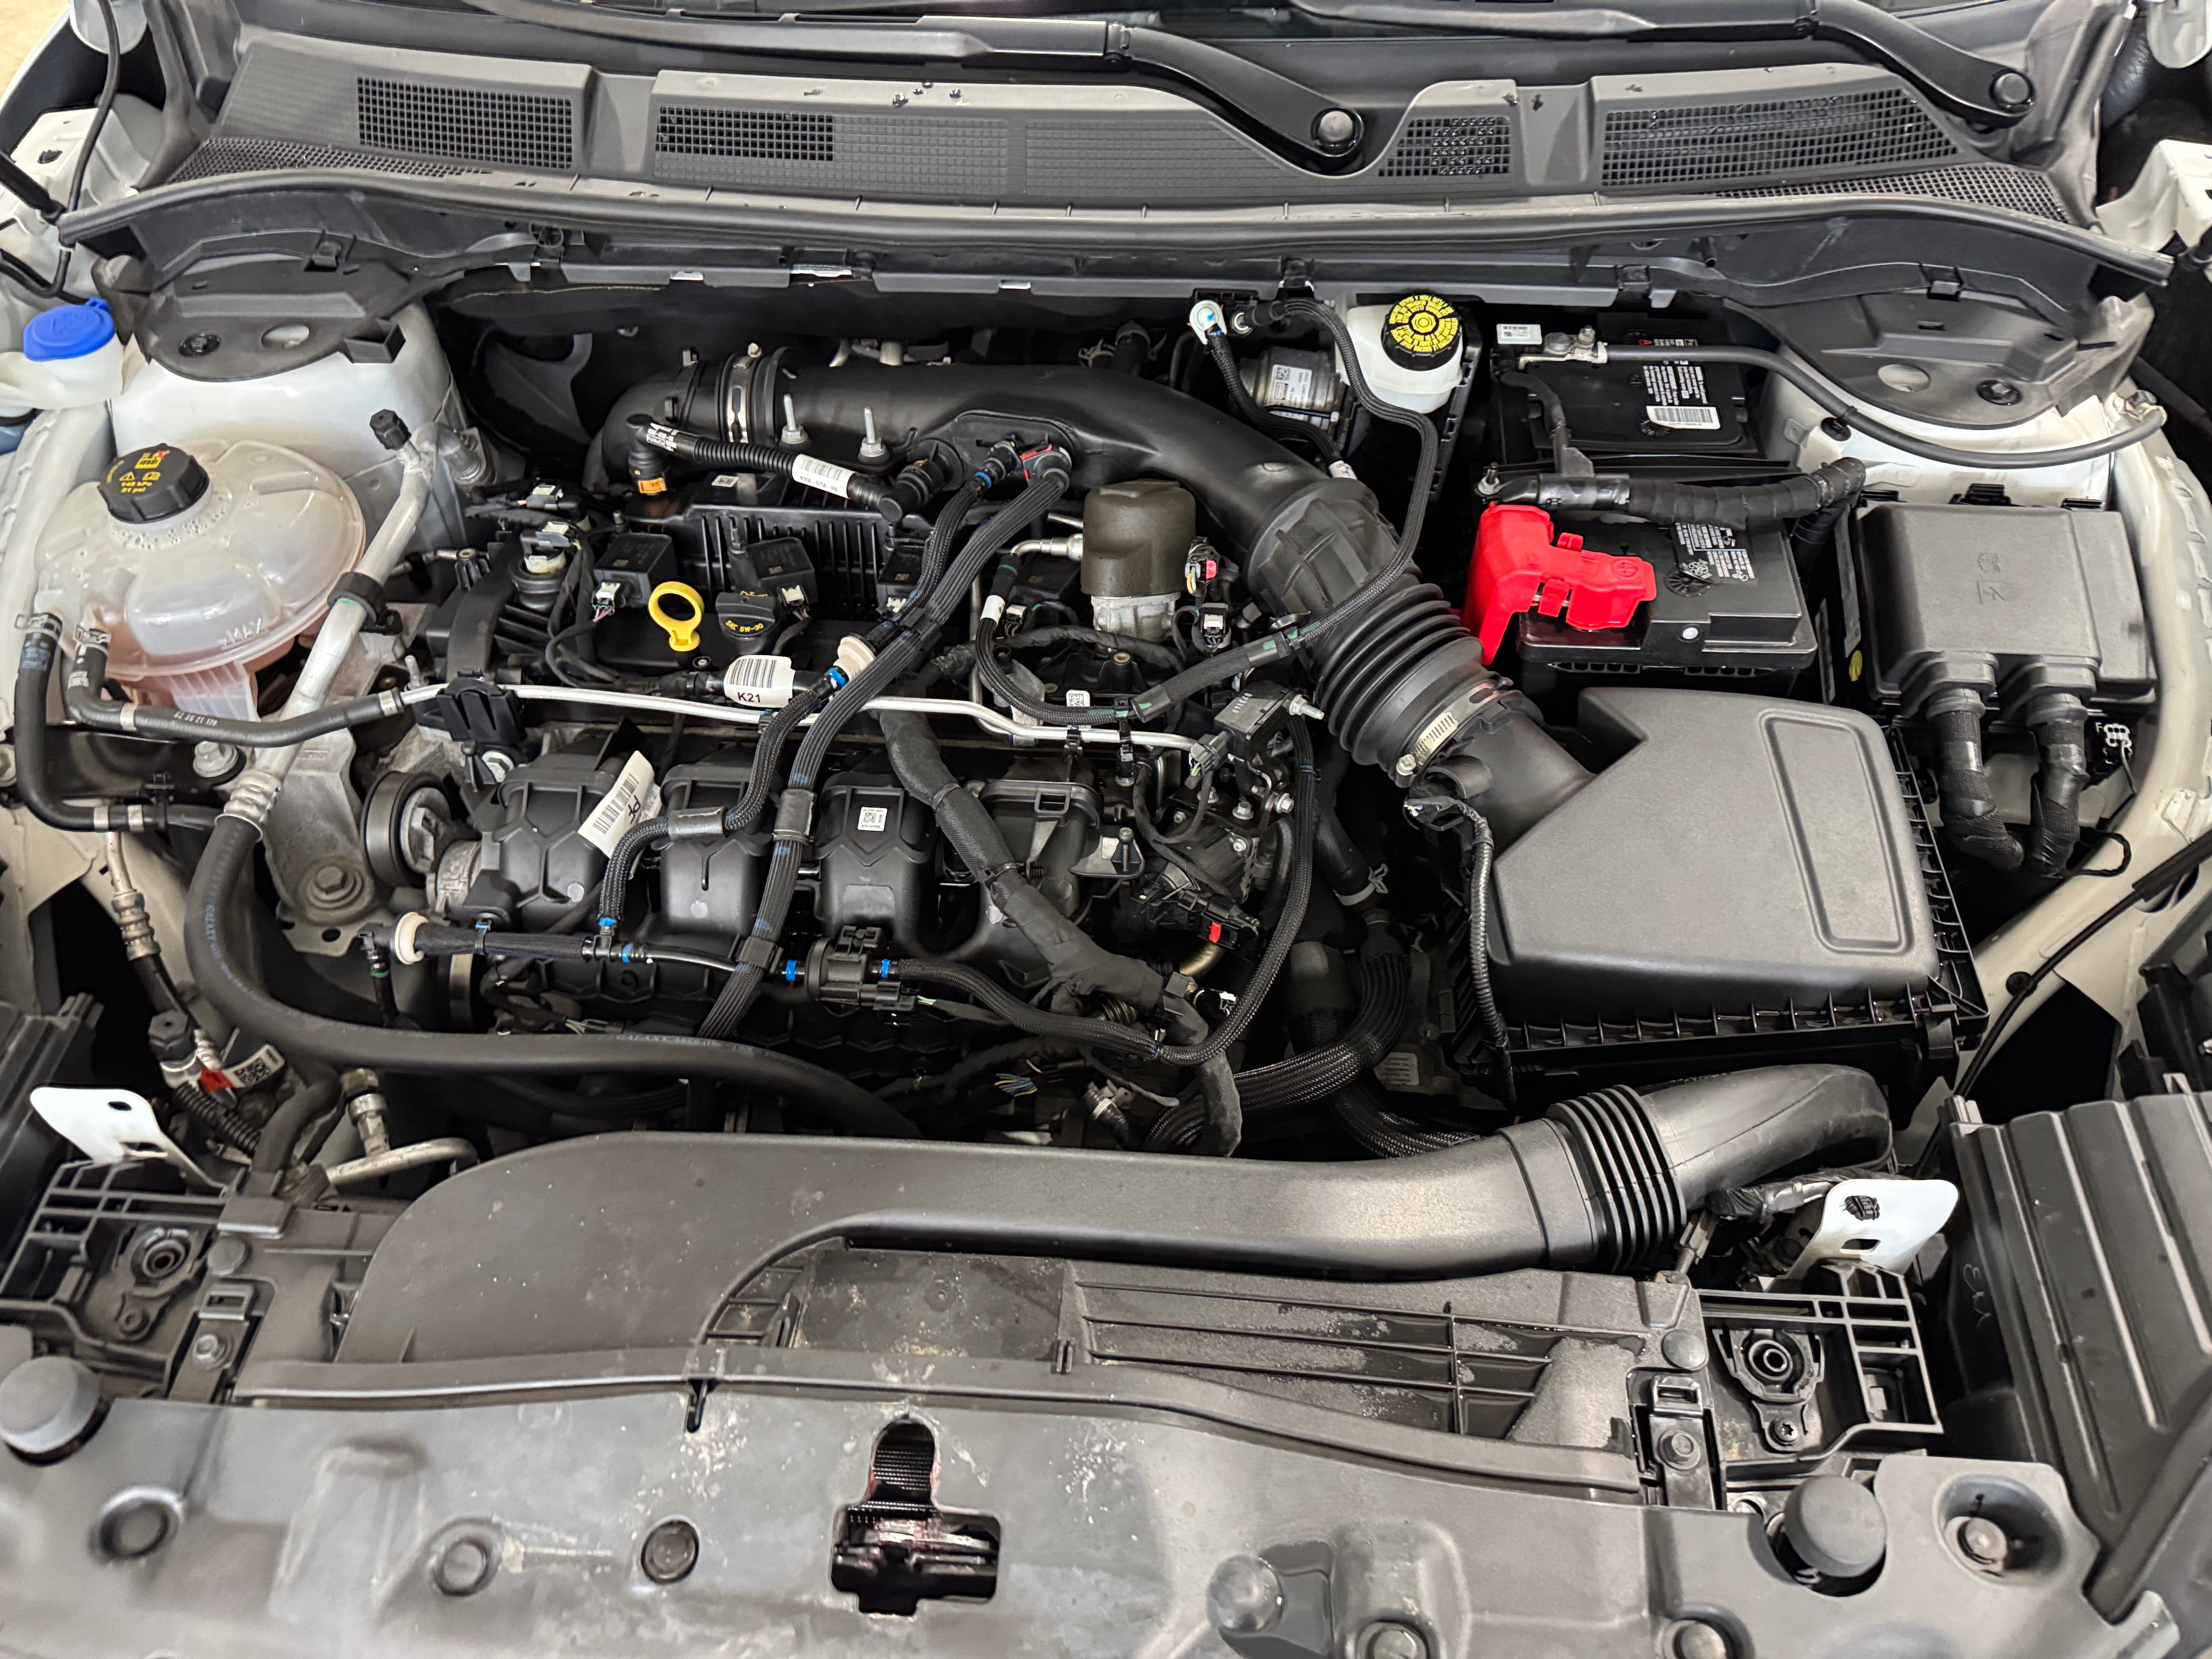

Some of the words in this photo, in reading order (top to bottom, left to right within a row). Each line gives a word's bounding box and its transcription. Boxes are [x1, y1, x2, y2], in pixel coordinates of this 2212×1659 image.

[725, 620, 738, 631] SAE
[740, 623, 764, 633] 5W-30
[737, 692, 761, 703] K21
[628, 794, 641, 824] PF
